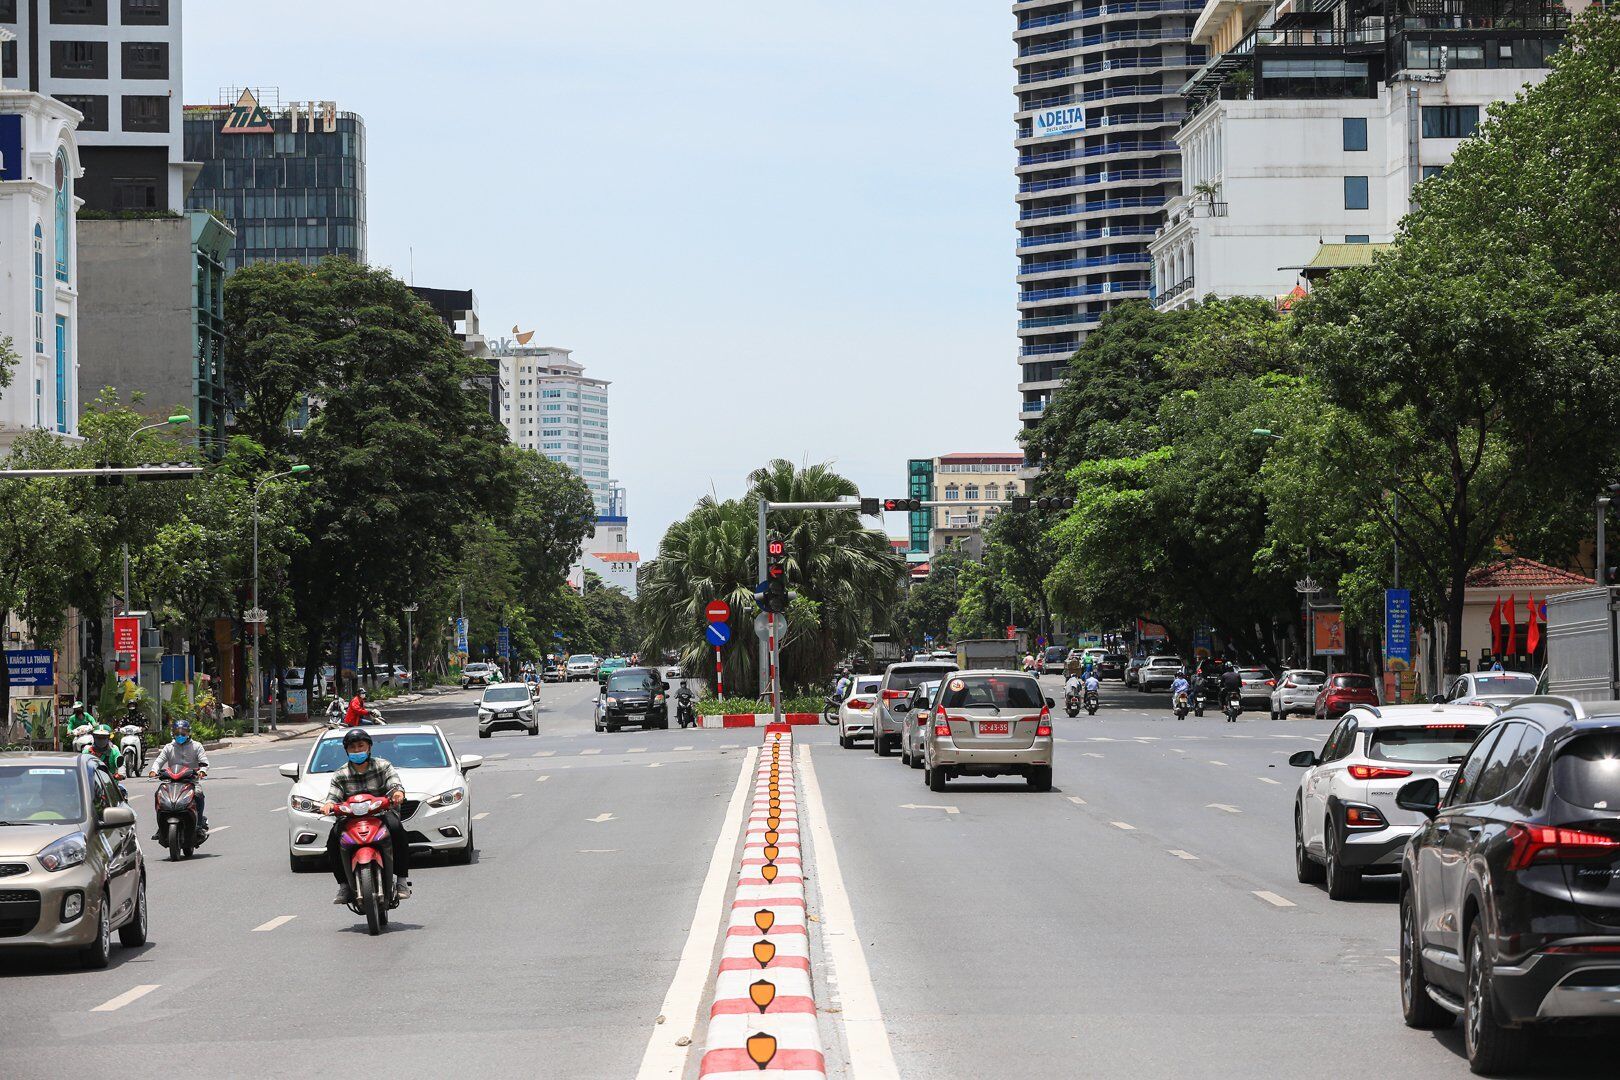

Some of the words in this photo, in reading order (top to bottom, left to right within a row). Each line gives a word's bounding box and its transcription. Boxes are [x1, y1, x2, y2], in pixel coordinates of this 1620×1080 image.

[1046, 107, 1083, 128] DELTA
[9, 654, 26, 665] KHÁCH
[26, 655, 34, 664] LA
[20, 667, 33, 675] GUEST
